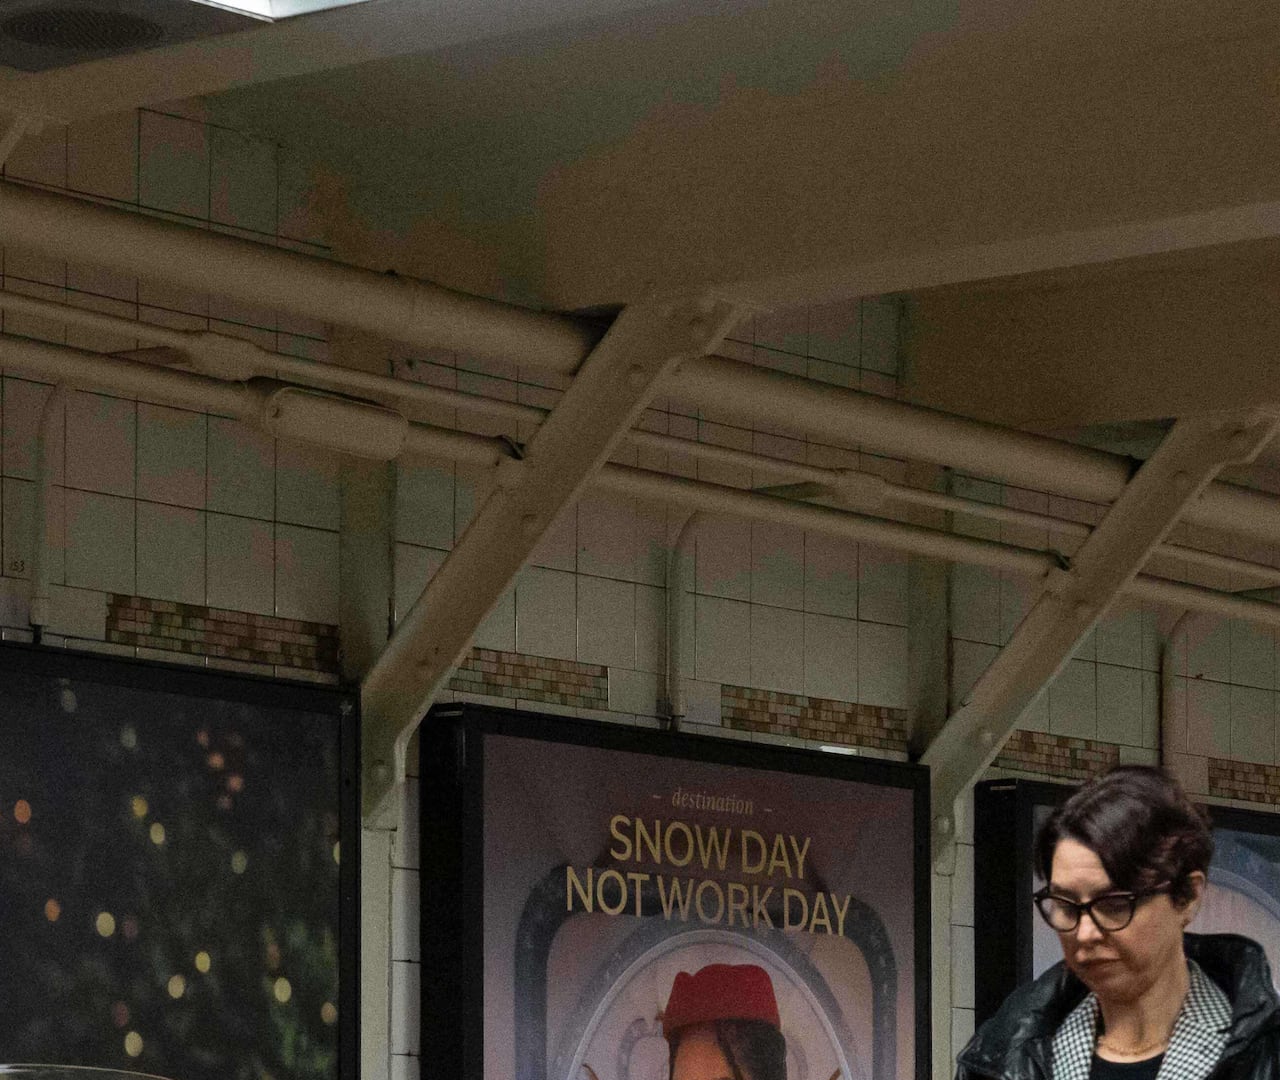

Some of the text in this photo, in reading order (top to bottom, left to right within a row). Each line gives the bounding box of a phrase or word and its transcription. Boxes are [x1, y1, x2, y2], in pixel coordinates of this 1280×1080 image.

[671, 787, 753, 816] destination
[609, 814, 811, 880] SNOW DAY
[566, 866, 852, 937] NOT WORK DAY
